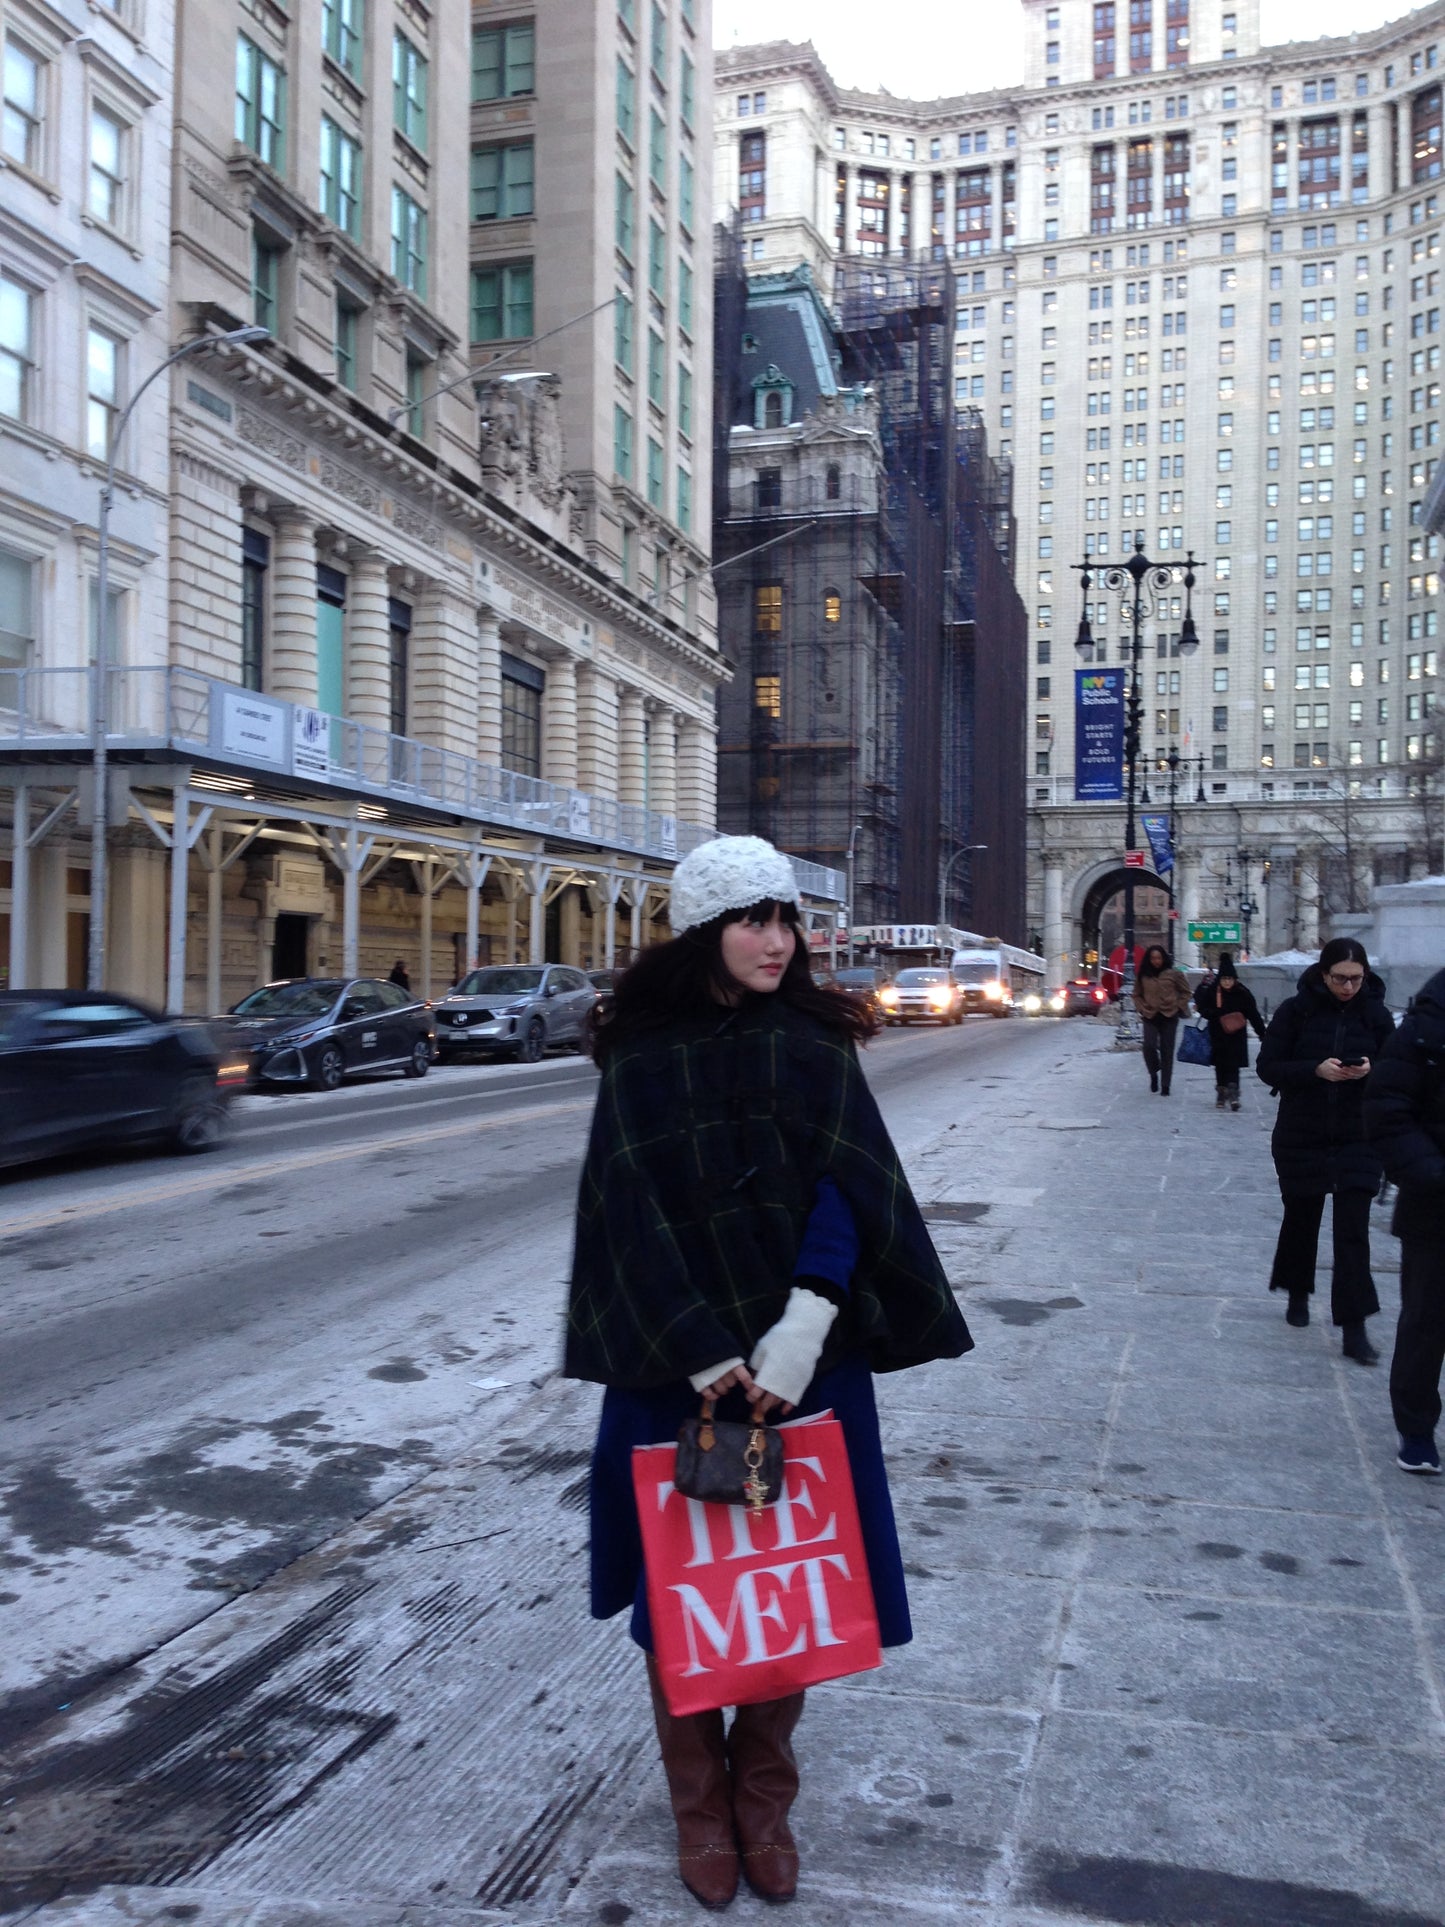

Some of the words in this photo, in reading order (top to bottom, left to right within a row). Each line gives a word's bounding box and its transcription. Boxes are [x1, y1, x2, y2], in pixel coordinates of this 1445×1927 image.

[1082, 676, 1116, 689] NYC
[1082, 689, 1112, 697] Public
[1082, 697, 1119, 705] Schools
[667, 1554, 851, 1677] MET
